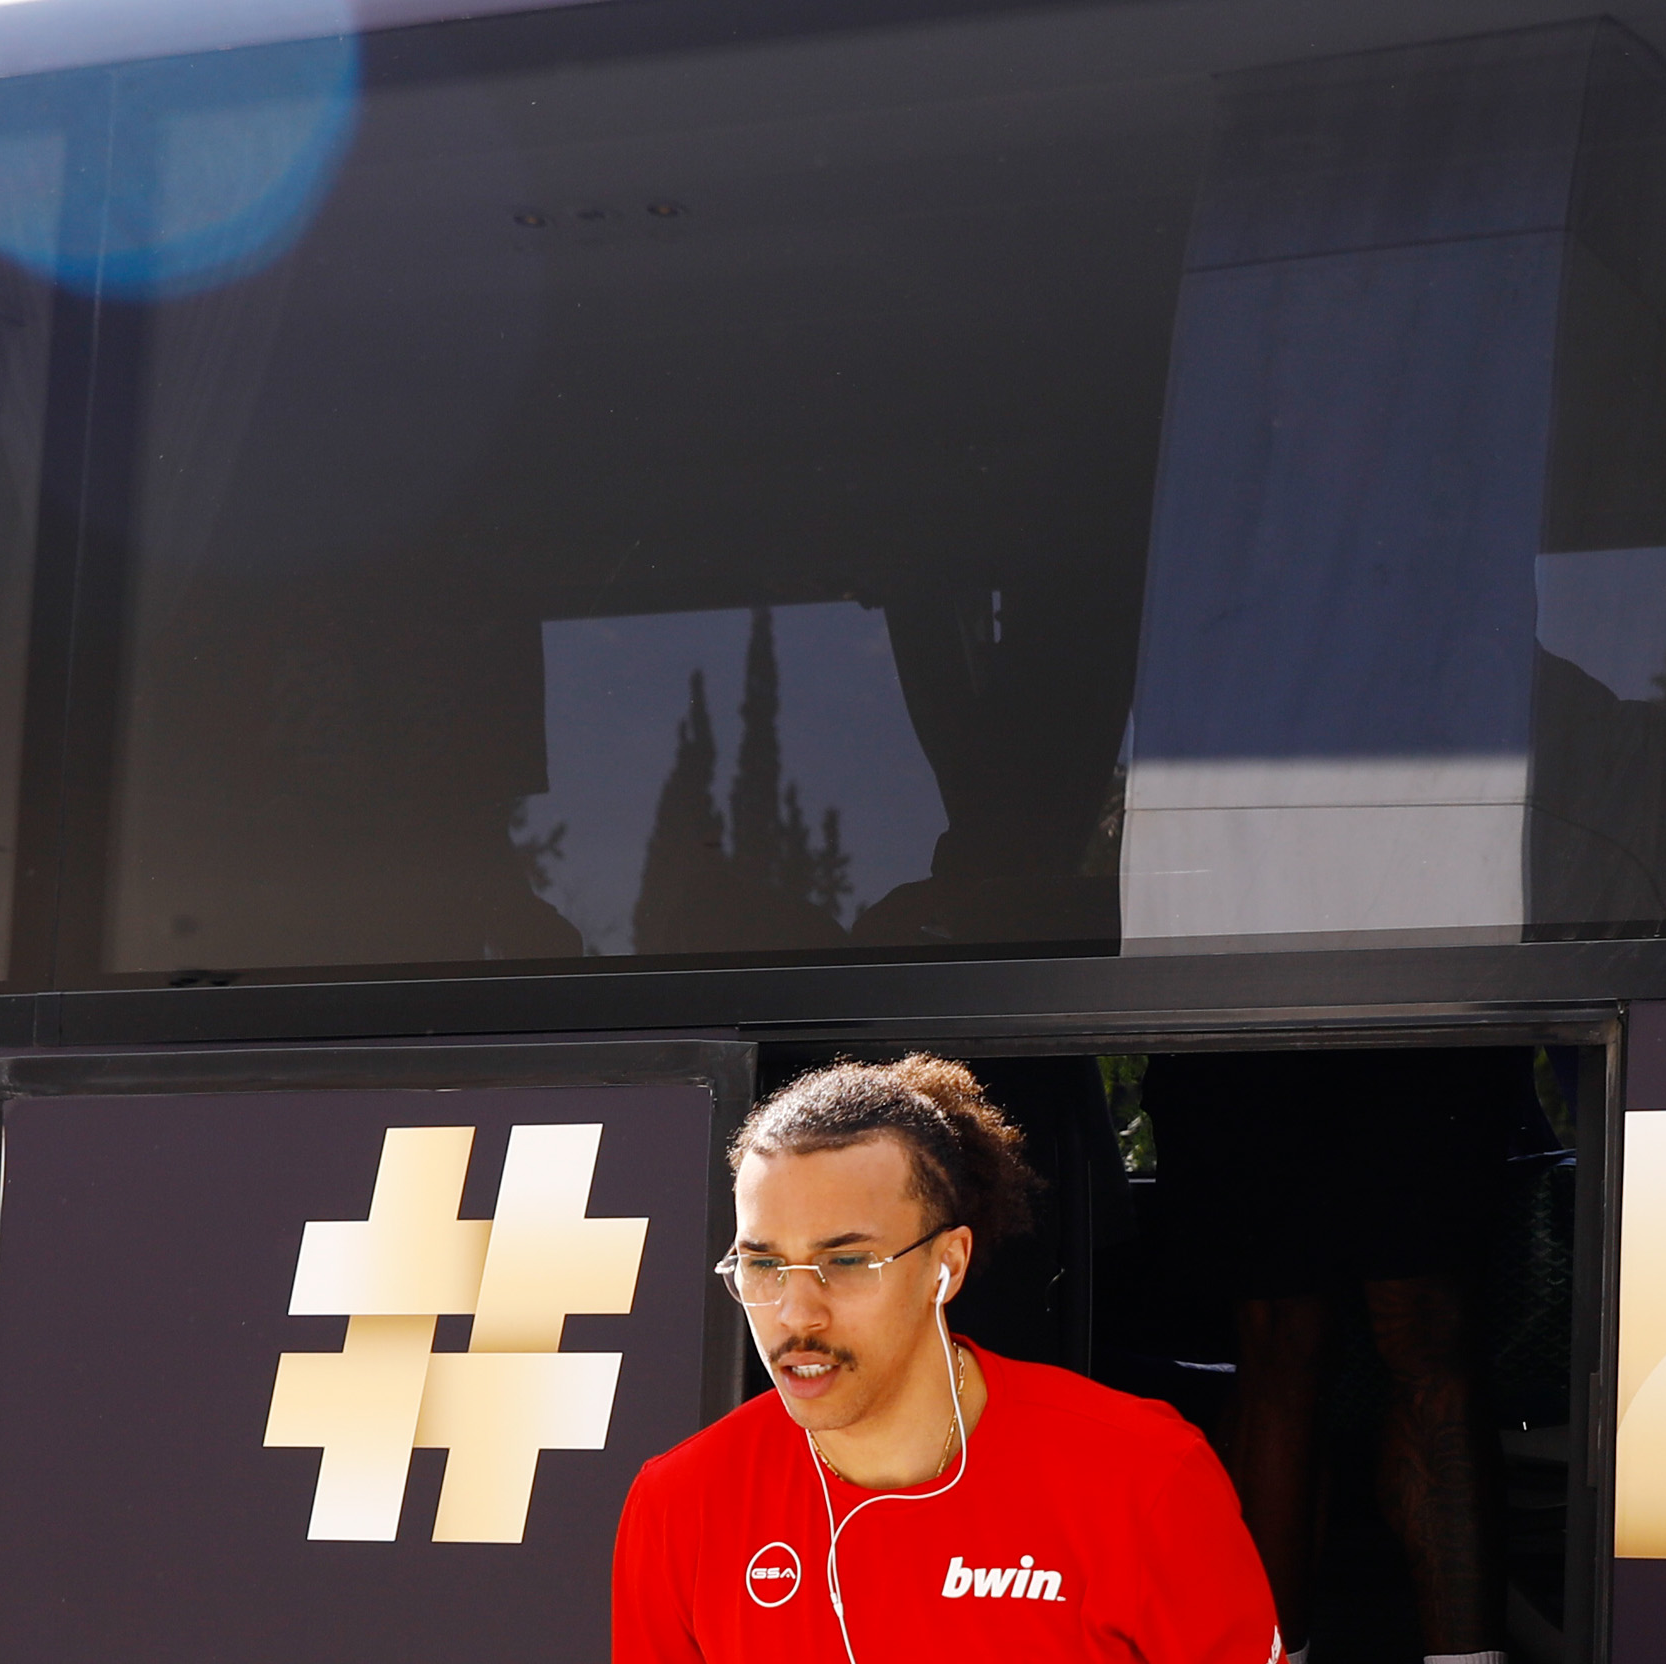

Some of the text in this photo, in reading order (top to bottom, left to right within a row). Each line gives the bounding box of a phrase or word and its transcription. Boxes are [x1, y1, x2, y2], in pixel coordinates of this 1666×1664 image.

[263, 1124, 650, 1544] #
[751, 1567, 796, 1579] GSA
[941, 1554, 1063, 1601] bwin
